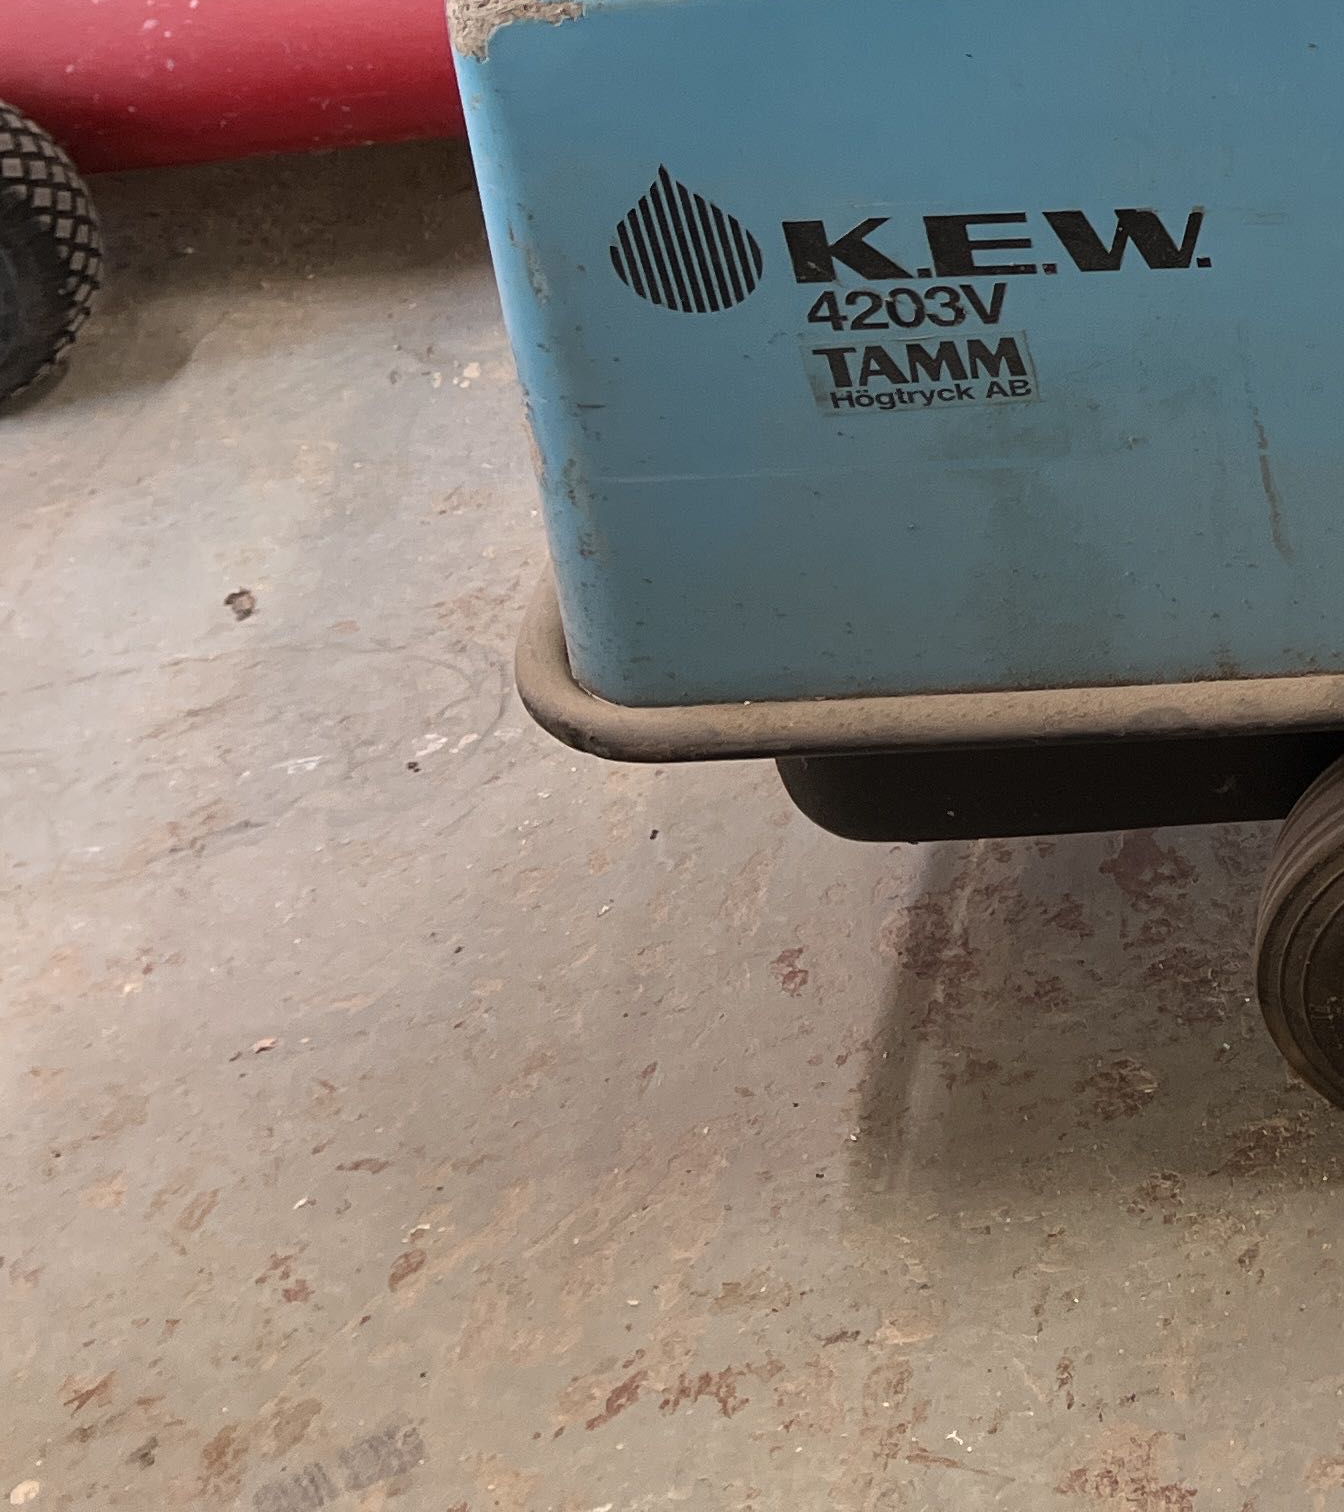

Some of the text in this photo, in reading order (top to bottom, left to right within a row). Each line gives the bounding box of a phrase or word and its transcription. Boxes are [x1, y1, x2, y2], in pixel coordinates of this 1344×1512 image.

[781, 205, 1212, 284] K.E.W.
[806, 282, 1008, 331] 4203V
[812, 336, 1028, 388] TAMM
[829, 379, 1033, 411] Högtryck AB
